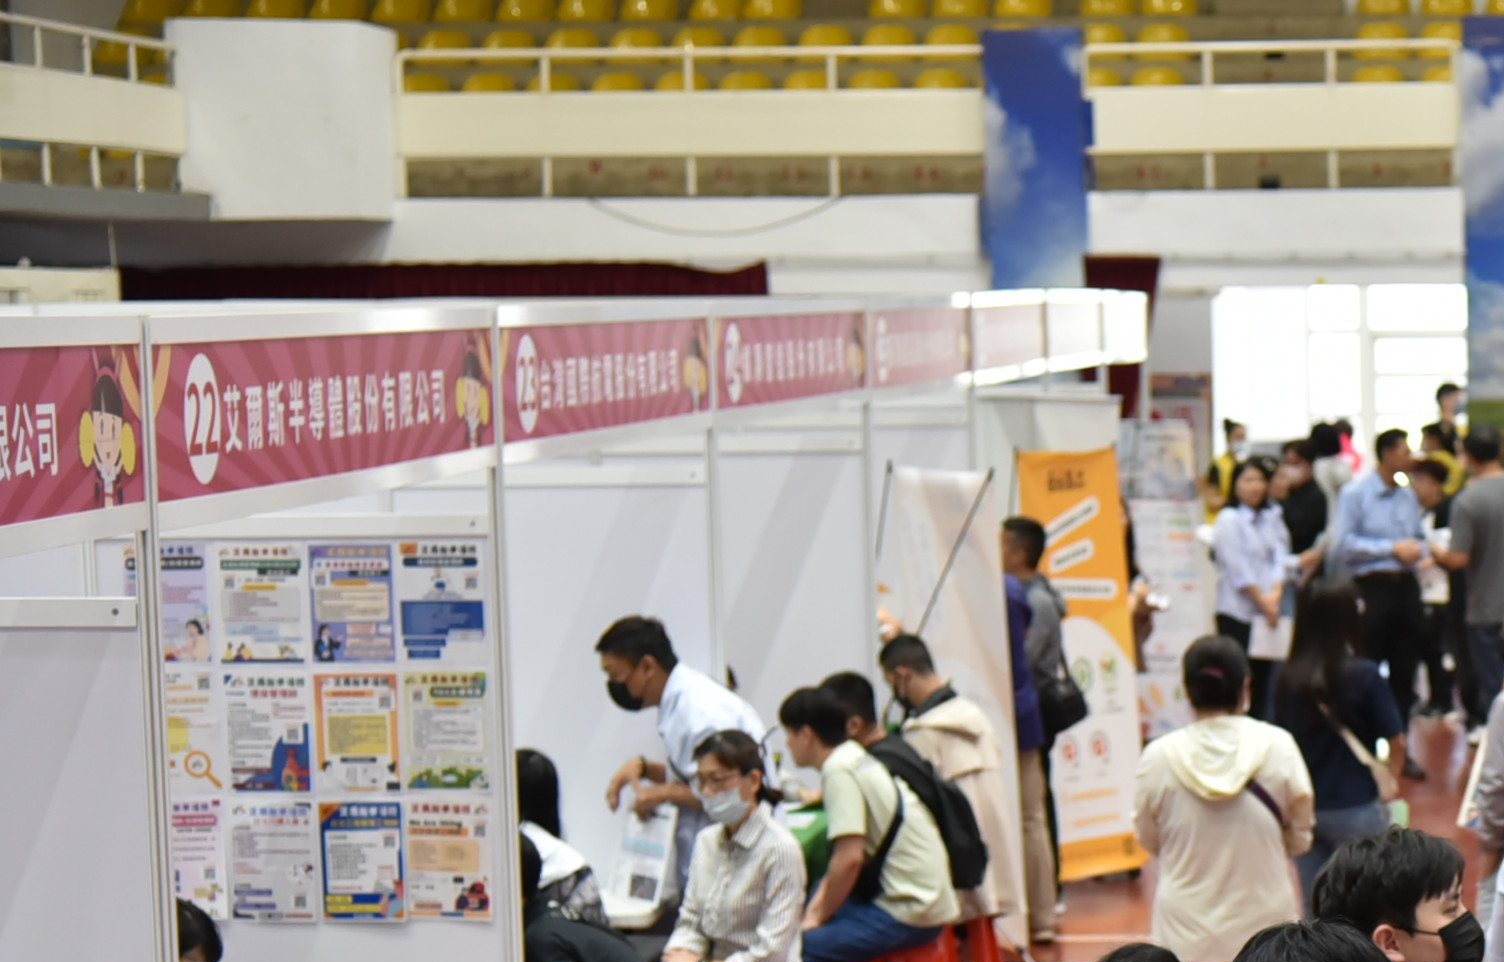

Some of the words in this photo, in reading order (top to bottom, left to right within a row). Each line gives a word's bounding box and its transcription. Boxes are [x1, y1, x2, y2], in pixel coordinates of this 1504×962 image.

[187, 380, 219, 457] 22
[223, 369, 446, 454] 艾爾斯半導體股份有限公司
